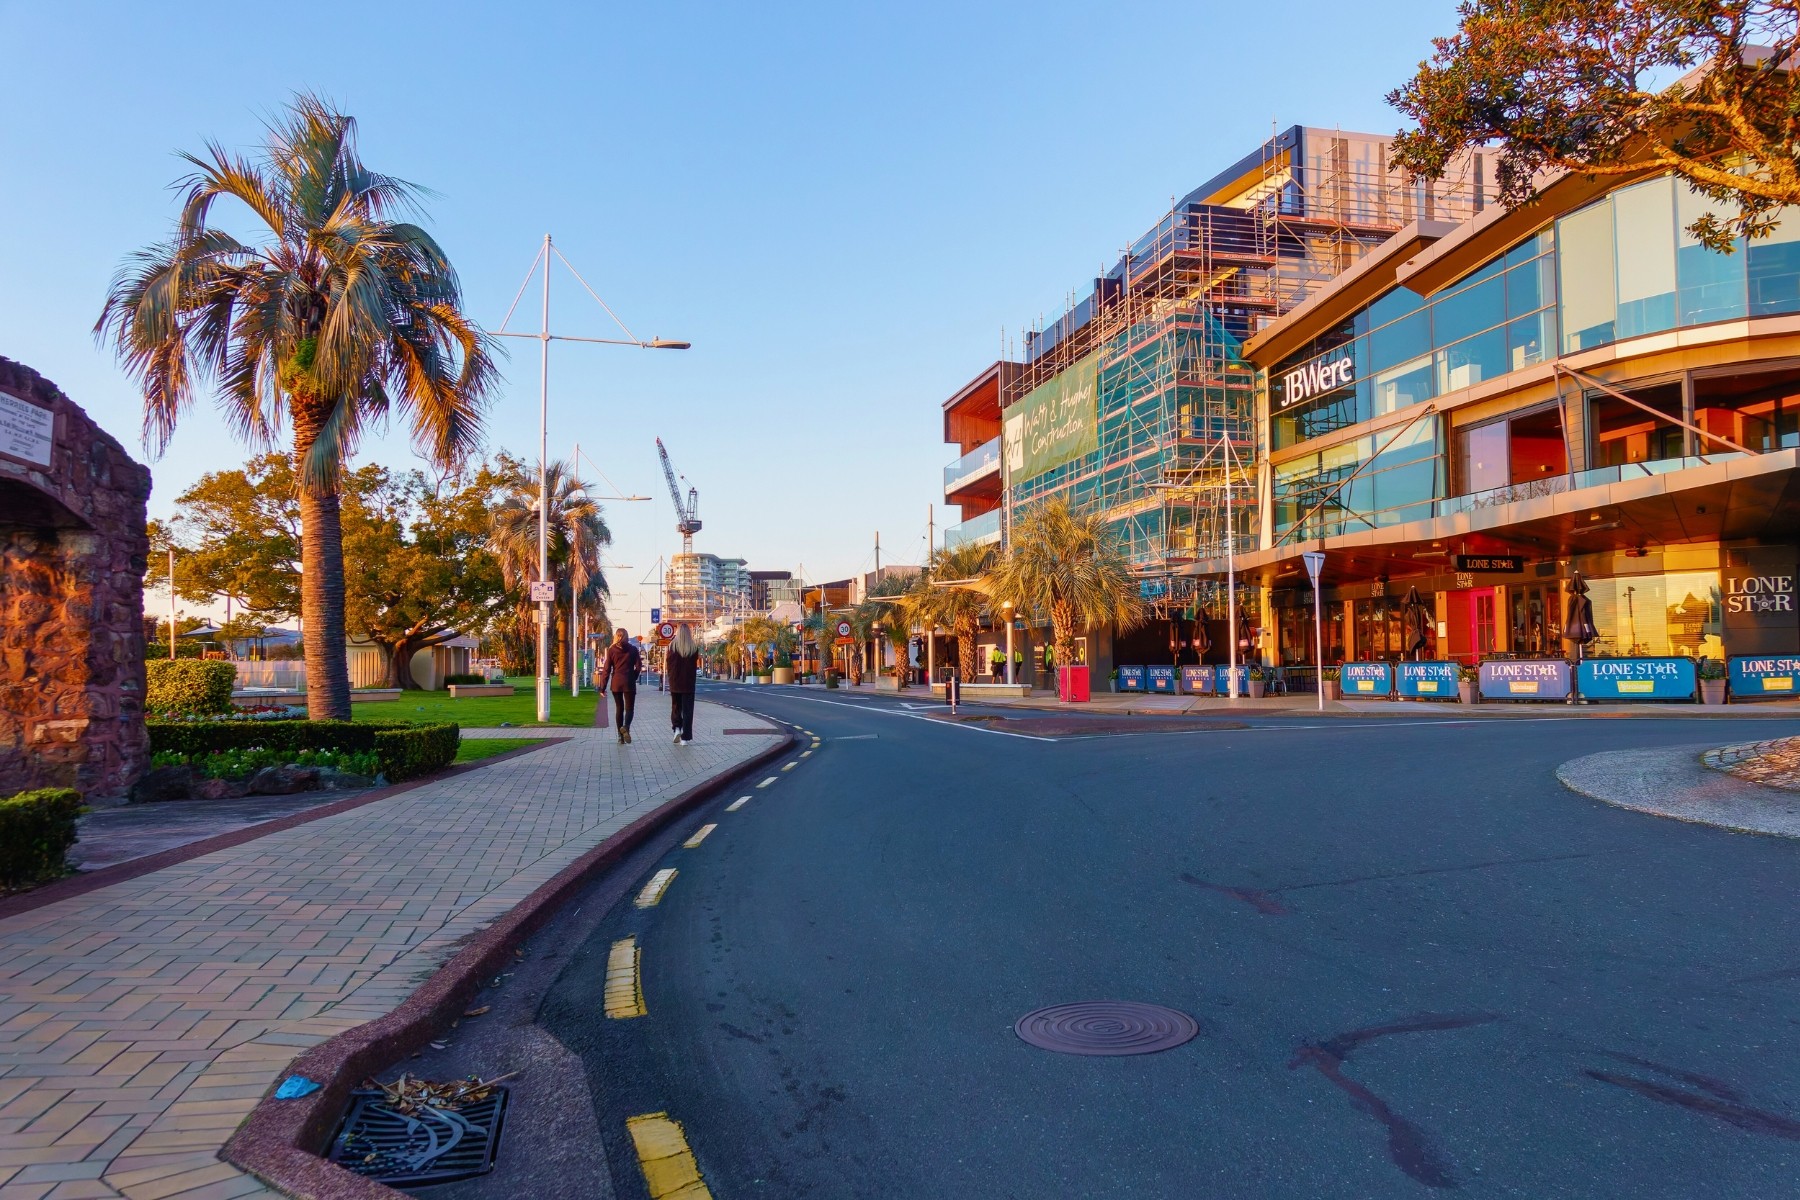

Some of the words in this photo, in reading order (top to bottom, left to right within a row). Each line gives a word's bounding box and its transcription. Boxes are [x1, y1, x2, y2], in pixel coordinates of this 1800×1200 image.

[1281, 357, 1352, 407] JBWere
[1050, 400, 1057, 423] &
[1060, 382, 1093, 419] Hughes
[1032, 415, 1084, 456] Construction
[1466, 559, 1490, 569] LONE
[1456, 572, 1474, 581] LONE
[1371, 582, 1385, 590] LONE
[1727, 576, 1793, 595] LONE
[840, 625, 848, 633] 30
[1347, 666, 1366, 677] LONE
[1404, 666, 1427, 676] LONE
[1491, 665, 1522, 676] LONE
[1592, 663, 1633, 675] LONE
[1741, 660, 1776, 672] LONE
[1220, 668, 1230, 678] LON
